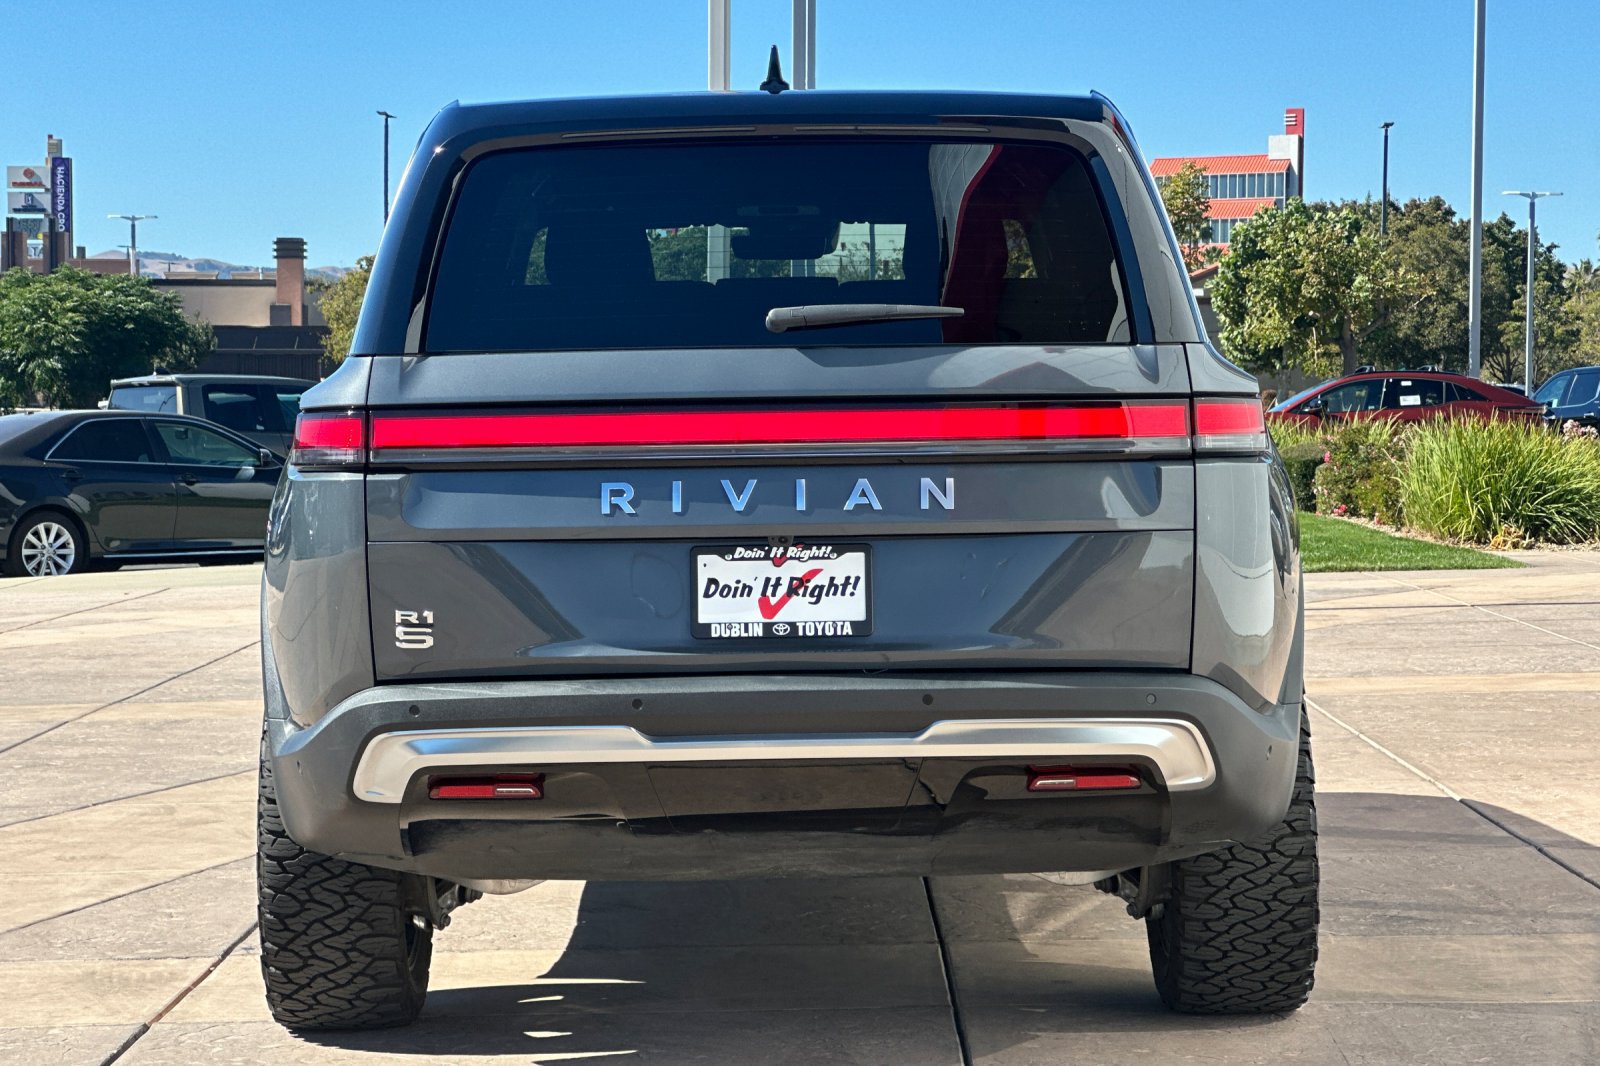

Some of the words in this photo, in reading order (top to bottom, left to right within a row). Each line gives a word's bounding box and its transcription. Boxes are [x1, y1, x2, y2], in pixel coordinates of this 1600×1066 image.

[56, 166, 65, 211] HACIENDA
[600, 477, 955, 515] RIVIAN
[734, 546, 768, 559] Doin'
[770, 547, 784, 558] It
[787, 546, 833, 561] Right!
[703, 576, 758, 599] Doin'
[761, 576, 783, 598] It
[786, 575, 861, 605] Right!
[395, 609, 434, 624] R1
[395, 625, 434, 649] S
[711, 622, 763, 638] DUBLIN
[796, 621, 853, 636] TOYOTA
